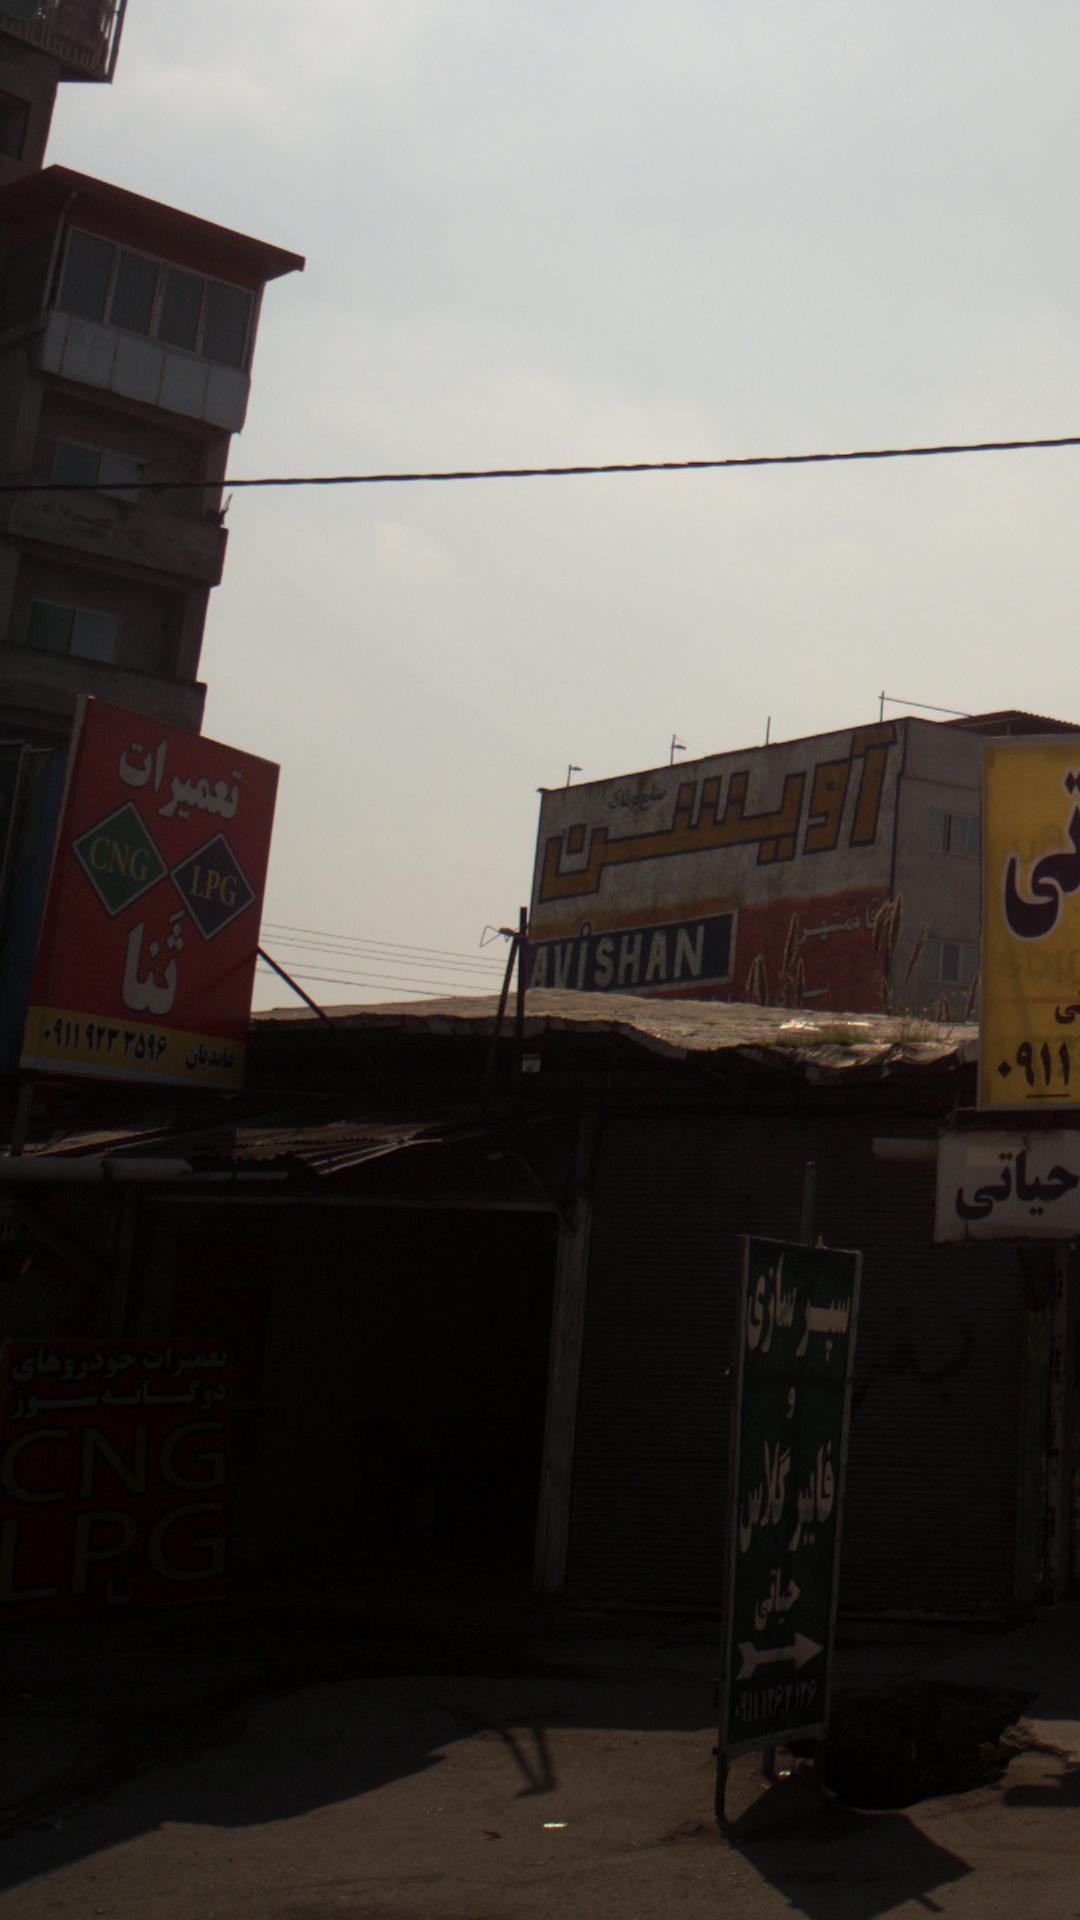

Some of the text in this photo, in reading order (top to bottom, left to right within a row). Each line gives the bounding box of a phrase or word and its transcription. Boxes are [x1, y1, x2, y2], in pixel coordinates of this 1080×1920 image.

[117, 738, 243, 821] تعمیرات
[88, 835, 149, 885] CNG
[188, 865, 239, 908] LPG
[998, 1042, 1071, 1087] ۰۹۱۱
[955, 1150, 1080, 1221] حیاتی
[747, 1249, 799, 1353] سازی
[785, 1386, 797, 1419] و
[0, 1421, 226, 1501] CNG
[739, 1439, 793, 1554] گلاس
[0, 1502, 226, 1602] LPG
